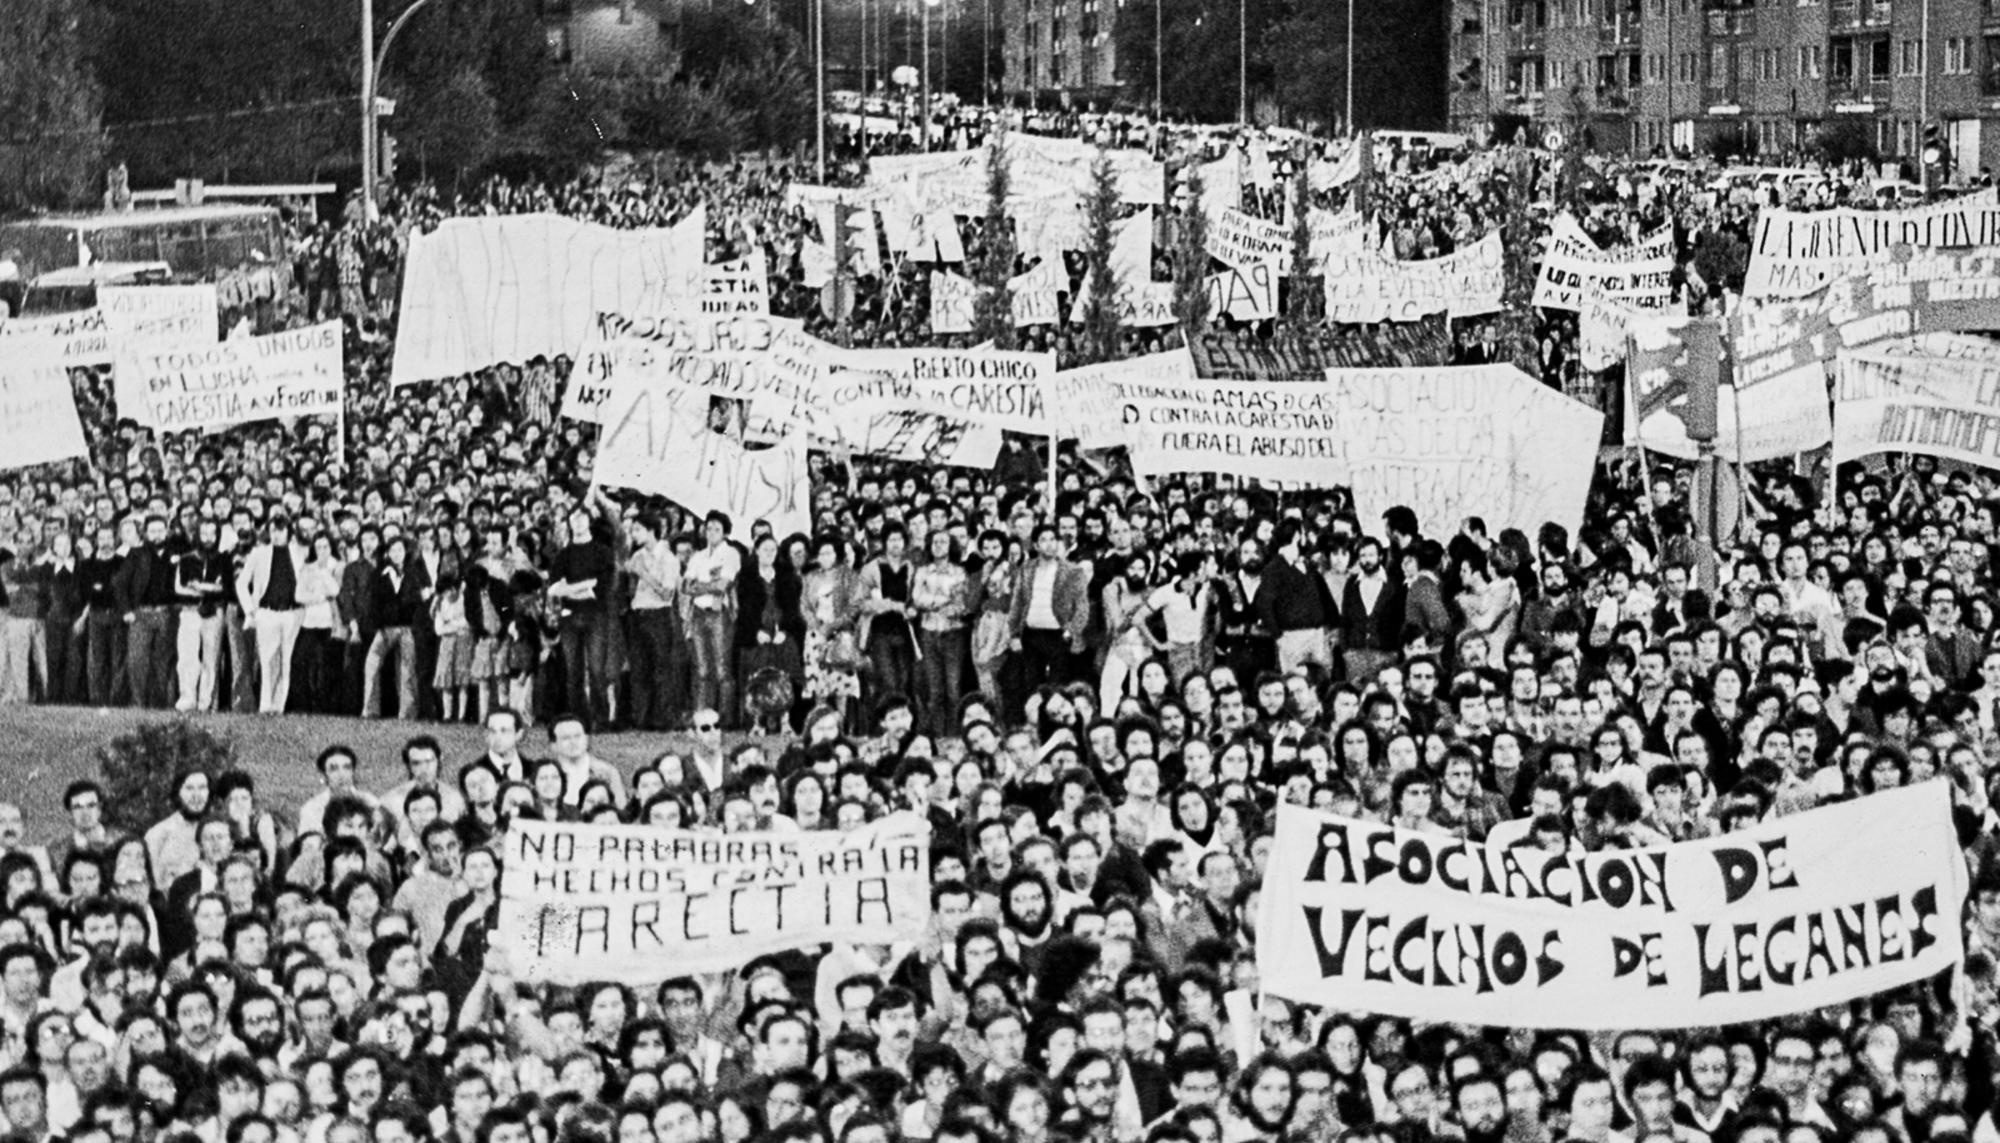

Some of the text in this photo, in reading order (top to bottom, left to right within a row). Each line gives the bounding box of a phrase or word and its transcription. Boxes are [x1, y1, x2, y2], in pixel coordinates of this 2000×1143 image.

[150, 347, 239, 372] TODOS
[980, 359, 1038, 381] CHICO
[179, 364, 259, 394] LUCHA
[1213, 388, 1278, 413] AMAS
[1298, 391, 1333, 411] CAS
[1150, 407, 1212, 424] CONTRA
[1238, 411, 1320, 430] CARESTIA
[1162, 431, 1222, 452] FUERA
[1250, 436, 1306, 458] ABUSO
[520, 831, 799, 864] NO PALABRAS
[1302, 822, 1800, 913] ASOCIACION DE
[533, 868, 687, 894] HECHOS
[1302, 884, 1938, 999] VECINOS DE LEGANES
